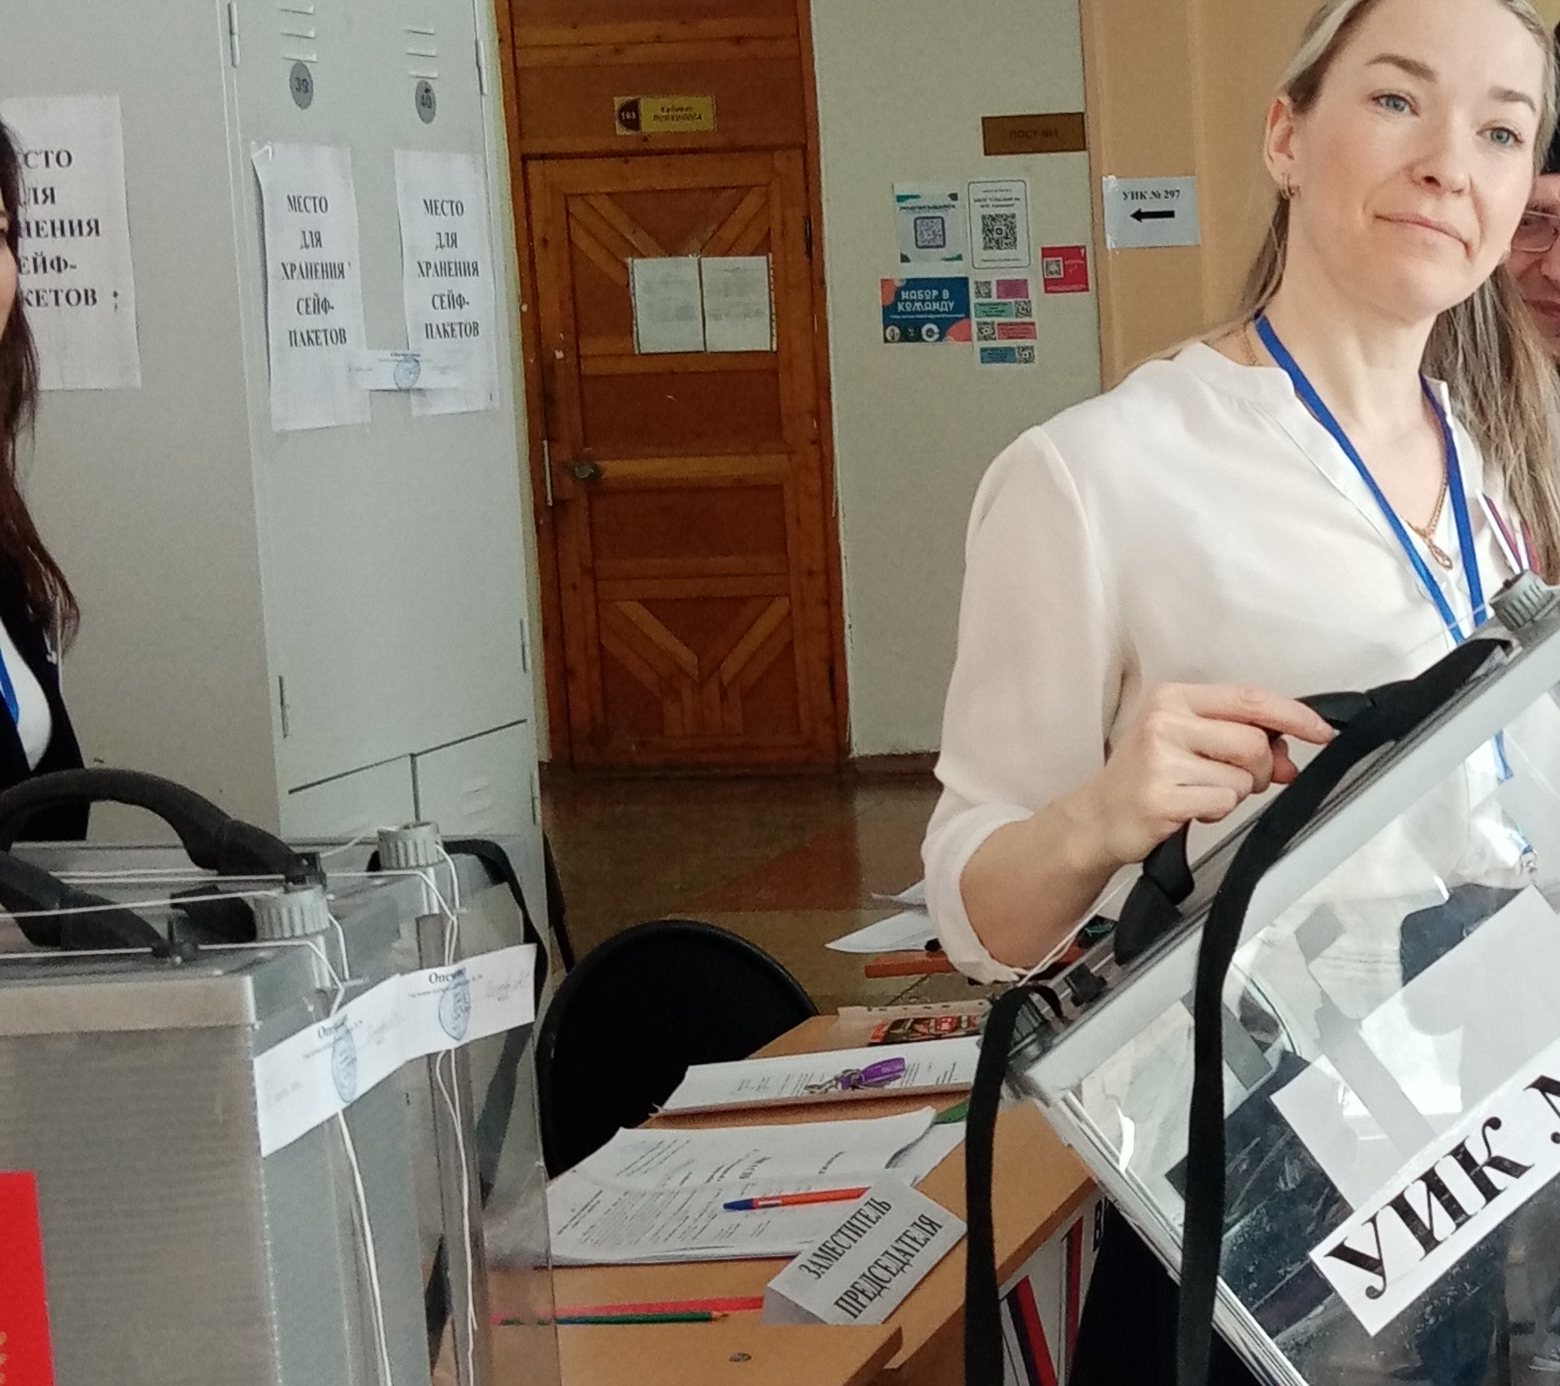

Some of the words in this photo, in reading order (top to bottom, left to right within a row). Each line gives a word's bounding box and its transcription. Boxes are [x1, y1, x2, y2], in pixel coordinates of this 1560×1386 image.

[19, 149, 73, 170] СТО
[287, 194, 329, 214] МЕСТО
[1122, 190, 1148, 202] УИК
[1163, 189, 1181, 200] 297
[422, 198, 465, 217] МЕСТО
[300, 230, 323, 251] ДЛЯ
[434, 231, 459, 251] ДЛЯ
[18, 251, 77, 275] ЕЙФ-
[281, 261, 346, 281] ХРАНЕНИЯ
[416, 260, 480, 278] ХРАНЕНИЯ
[22, 287, 98, 308] КЕТОВ
[296, 292, 335, 315] СЕЙФ-
[431, 289, 470, 311] СЕЙФ-
[288, 327, 347, 348] ПАКЕТОВ
[424, 321, 480, 340] ПАКЕТОВ
[1323, 1116, 1535, 1300] УИК
[798, 1197, 892, 1280] ЗАМЕСТИТЕЛЬ
[833, 1213, 943, 1320] ПРЕДСЕДАТЕЛЯ
